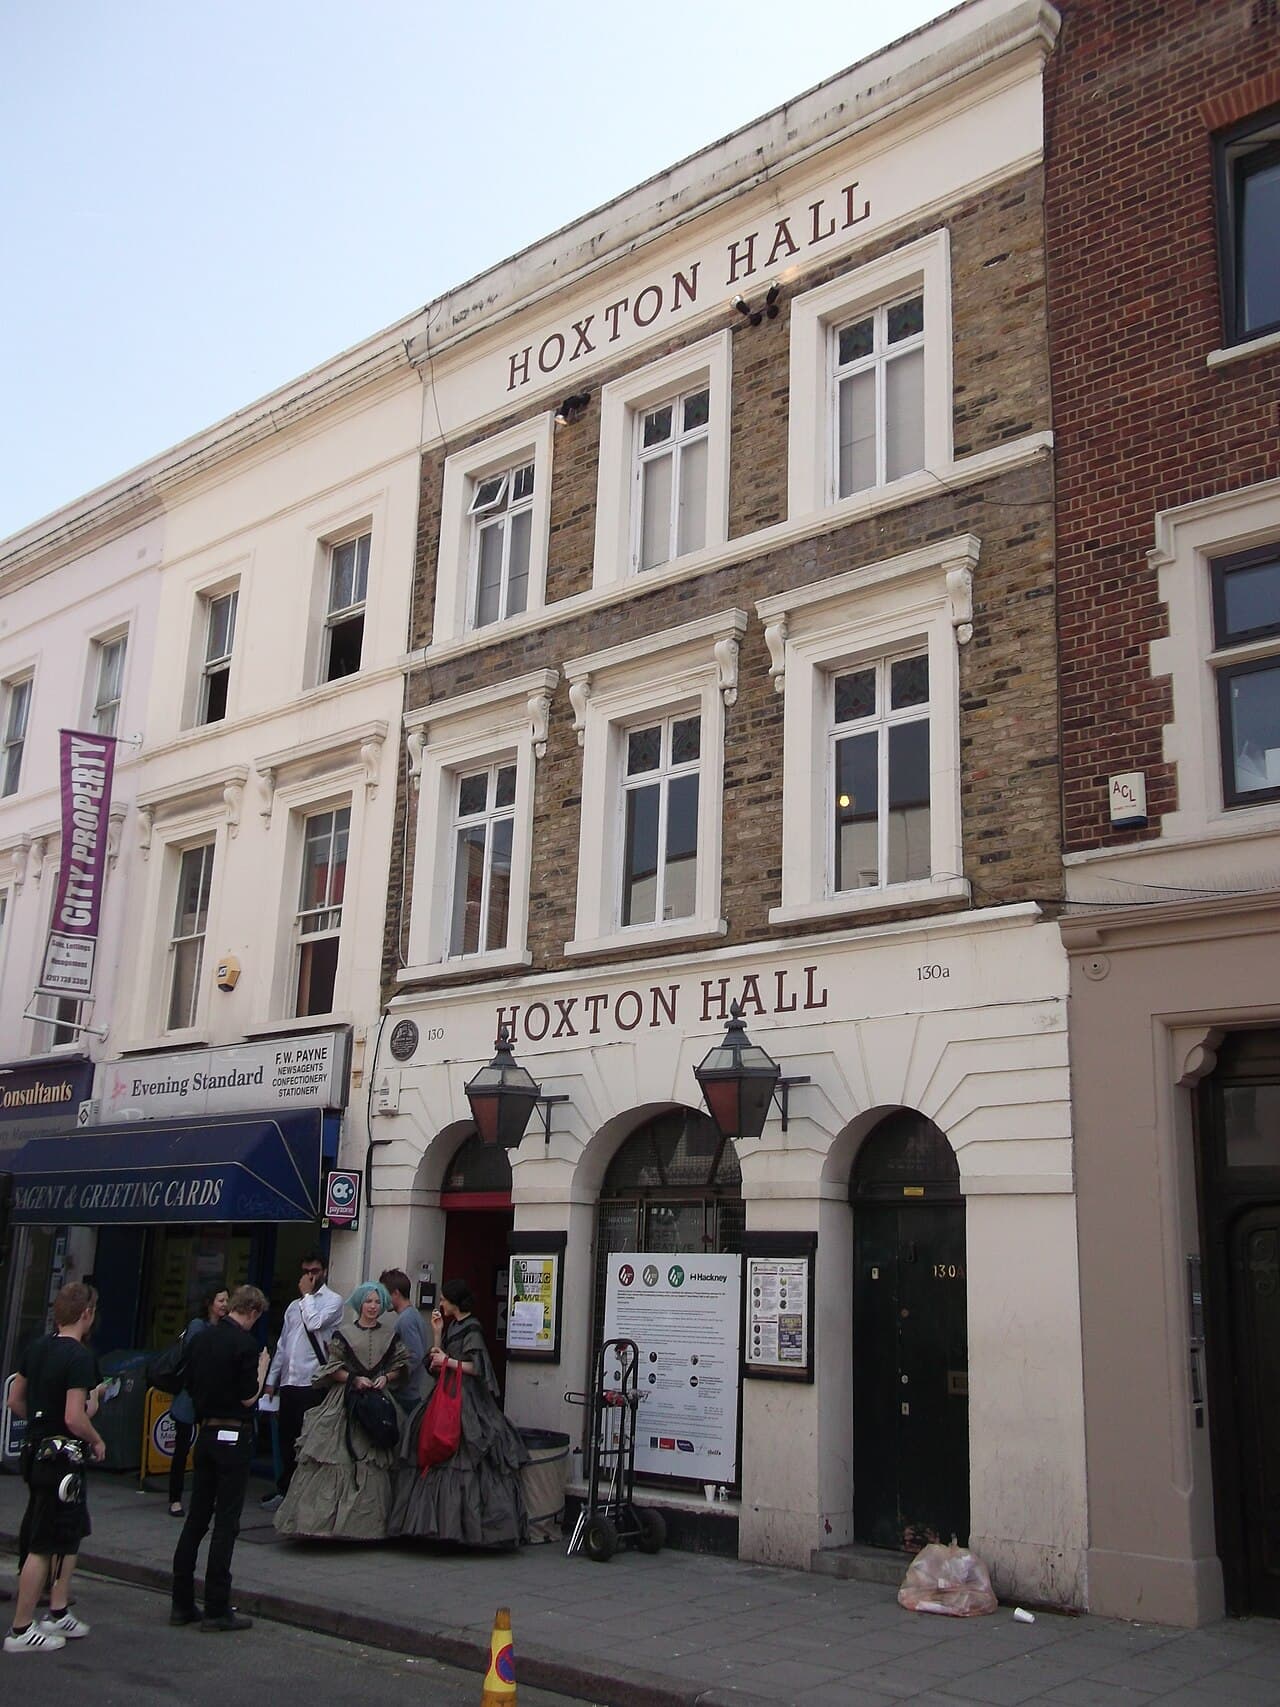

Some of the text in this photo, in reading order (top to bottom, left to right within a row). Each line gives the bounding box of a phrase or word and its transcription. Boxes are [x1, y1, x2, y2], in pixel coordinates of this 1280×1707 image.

[507, 182, 870, 391] HOXTON HALL
[1113, 781, 1137, 802] ACL
[60, 736, 107, 927] CITY PROPERTY
[917, 964, 950, 981] 130a
[494, 966, 828, 1045] HOXTON HALL
[428, 1028, 444, 1041] 130
[296, 1047, 328, 1062] PAYNE
[278, 1063, 324, 1075] NEWSAGENTS
[131, 1066, 263, 1097] Evening Standard
[272, 1073, 328, 1087] CONFECTIONERY
[278, 1085, 319, 1098] STATIONERY
[80, 1181, 163, 1208] GREETING
[164, 1178, 224, 1207] CARDS
[328, 1206, 354, 1215] payzone
[697, 1273, 728, 1284] Hackney
